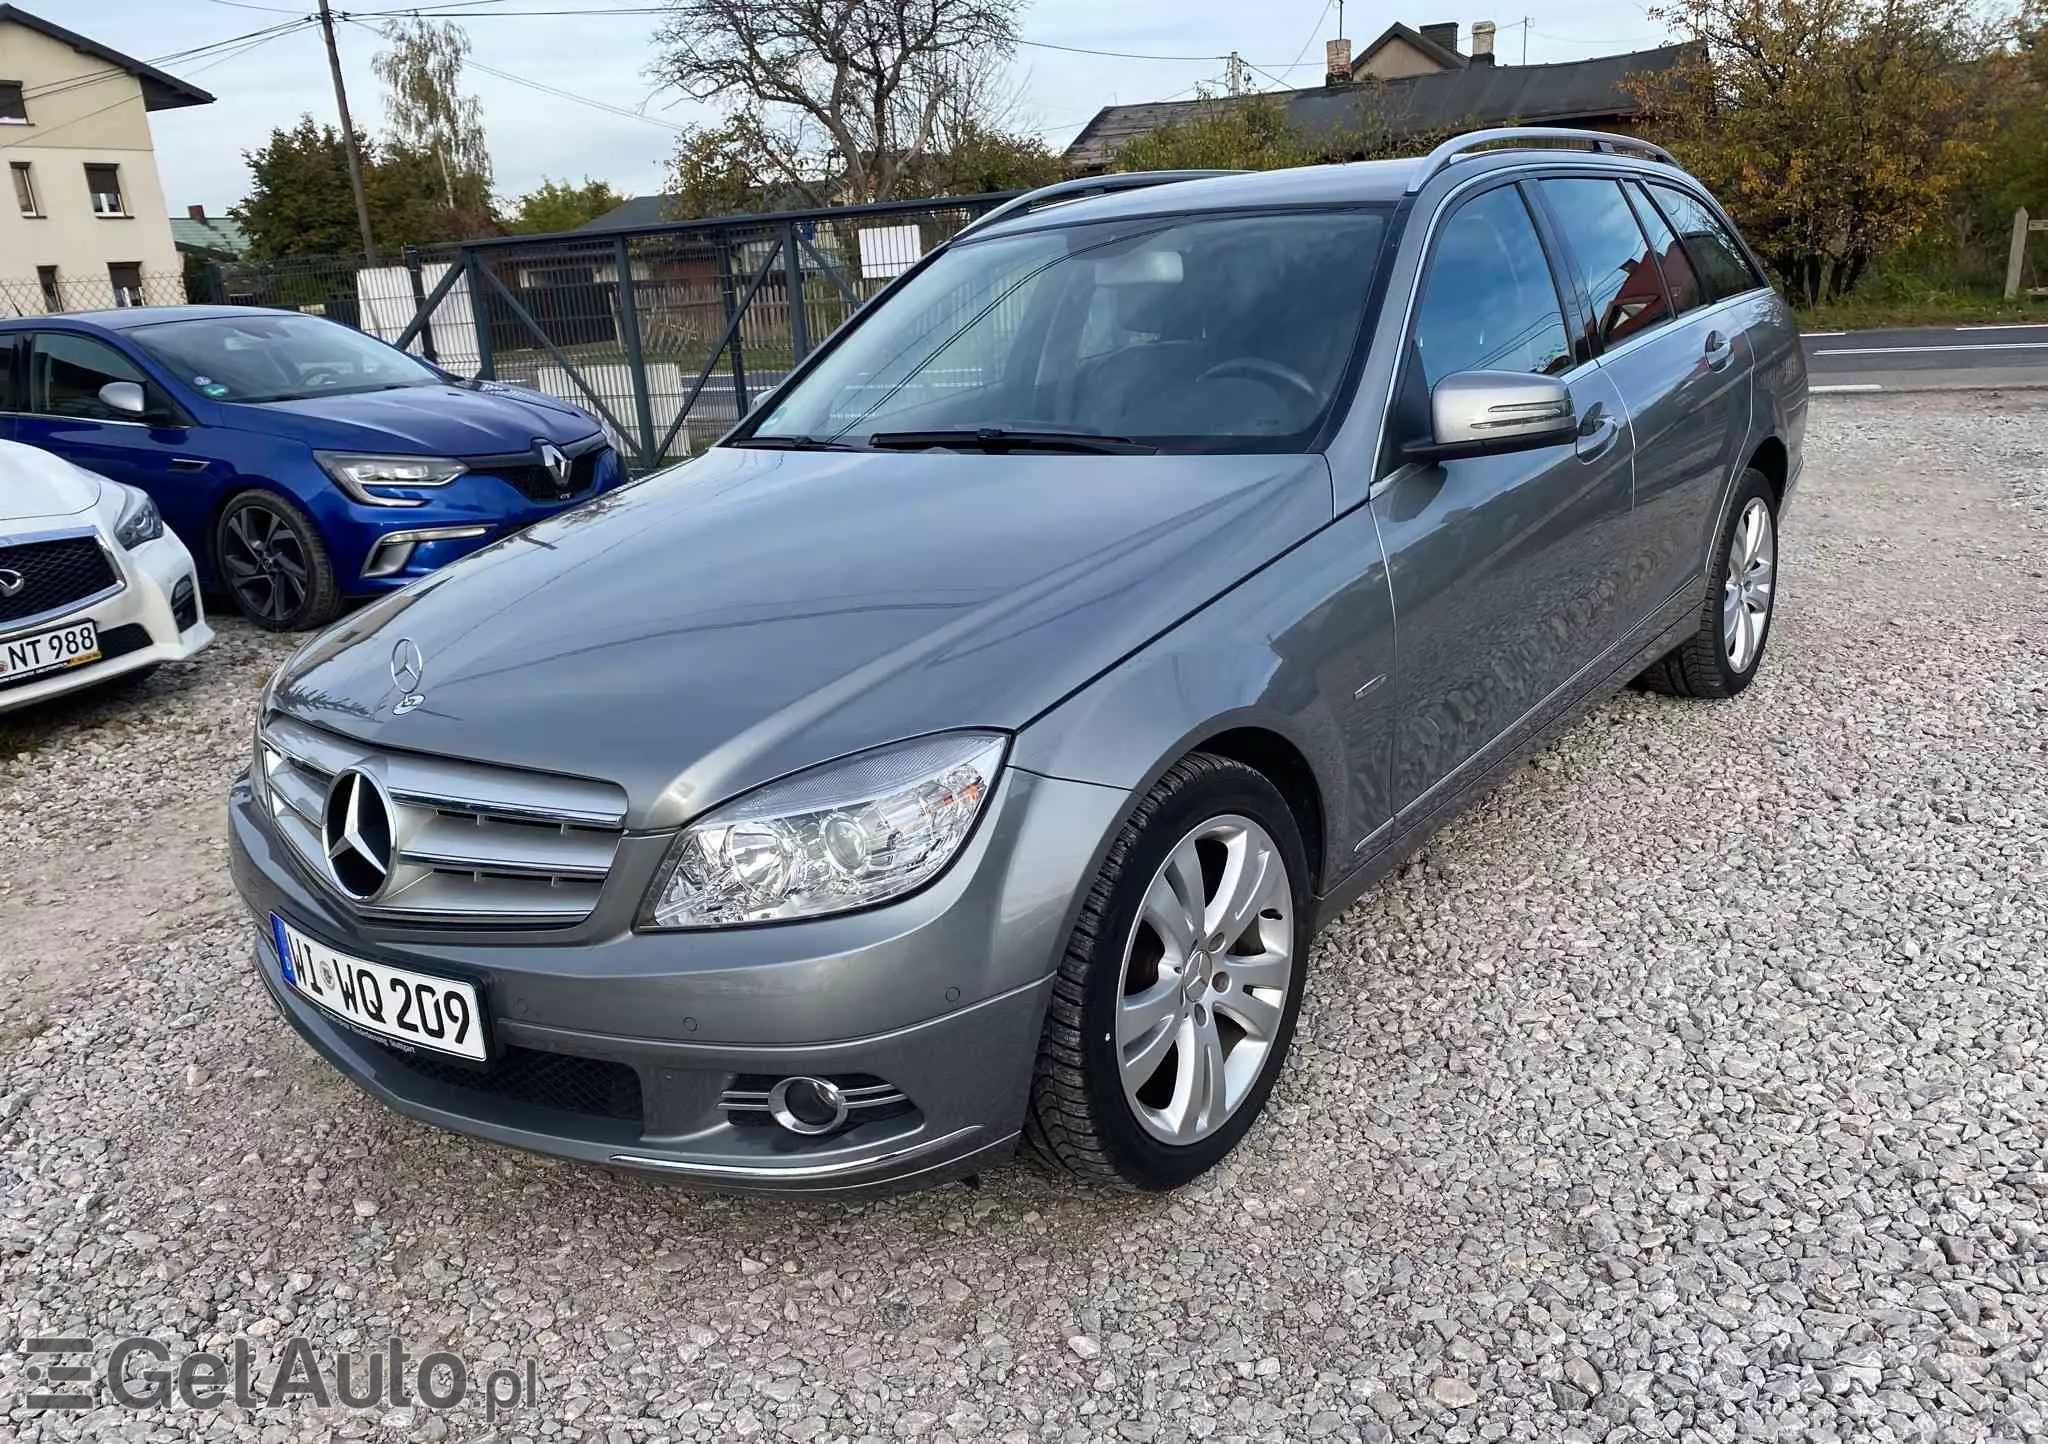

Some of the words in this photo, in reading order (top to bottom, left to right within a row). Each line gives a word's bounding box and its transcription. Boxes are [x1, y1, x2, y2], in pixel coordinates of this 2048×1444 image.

[8, 639, 41, 670] NT
[48, 627, 94, 660] 988
[287, 931, 325, 997] WI
[333, 958, 387, 1025] WQ
[390, 977, 471, 1045] 209
